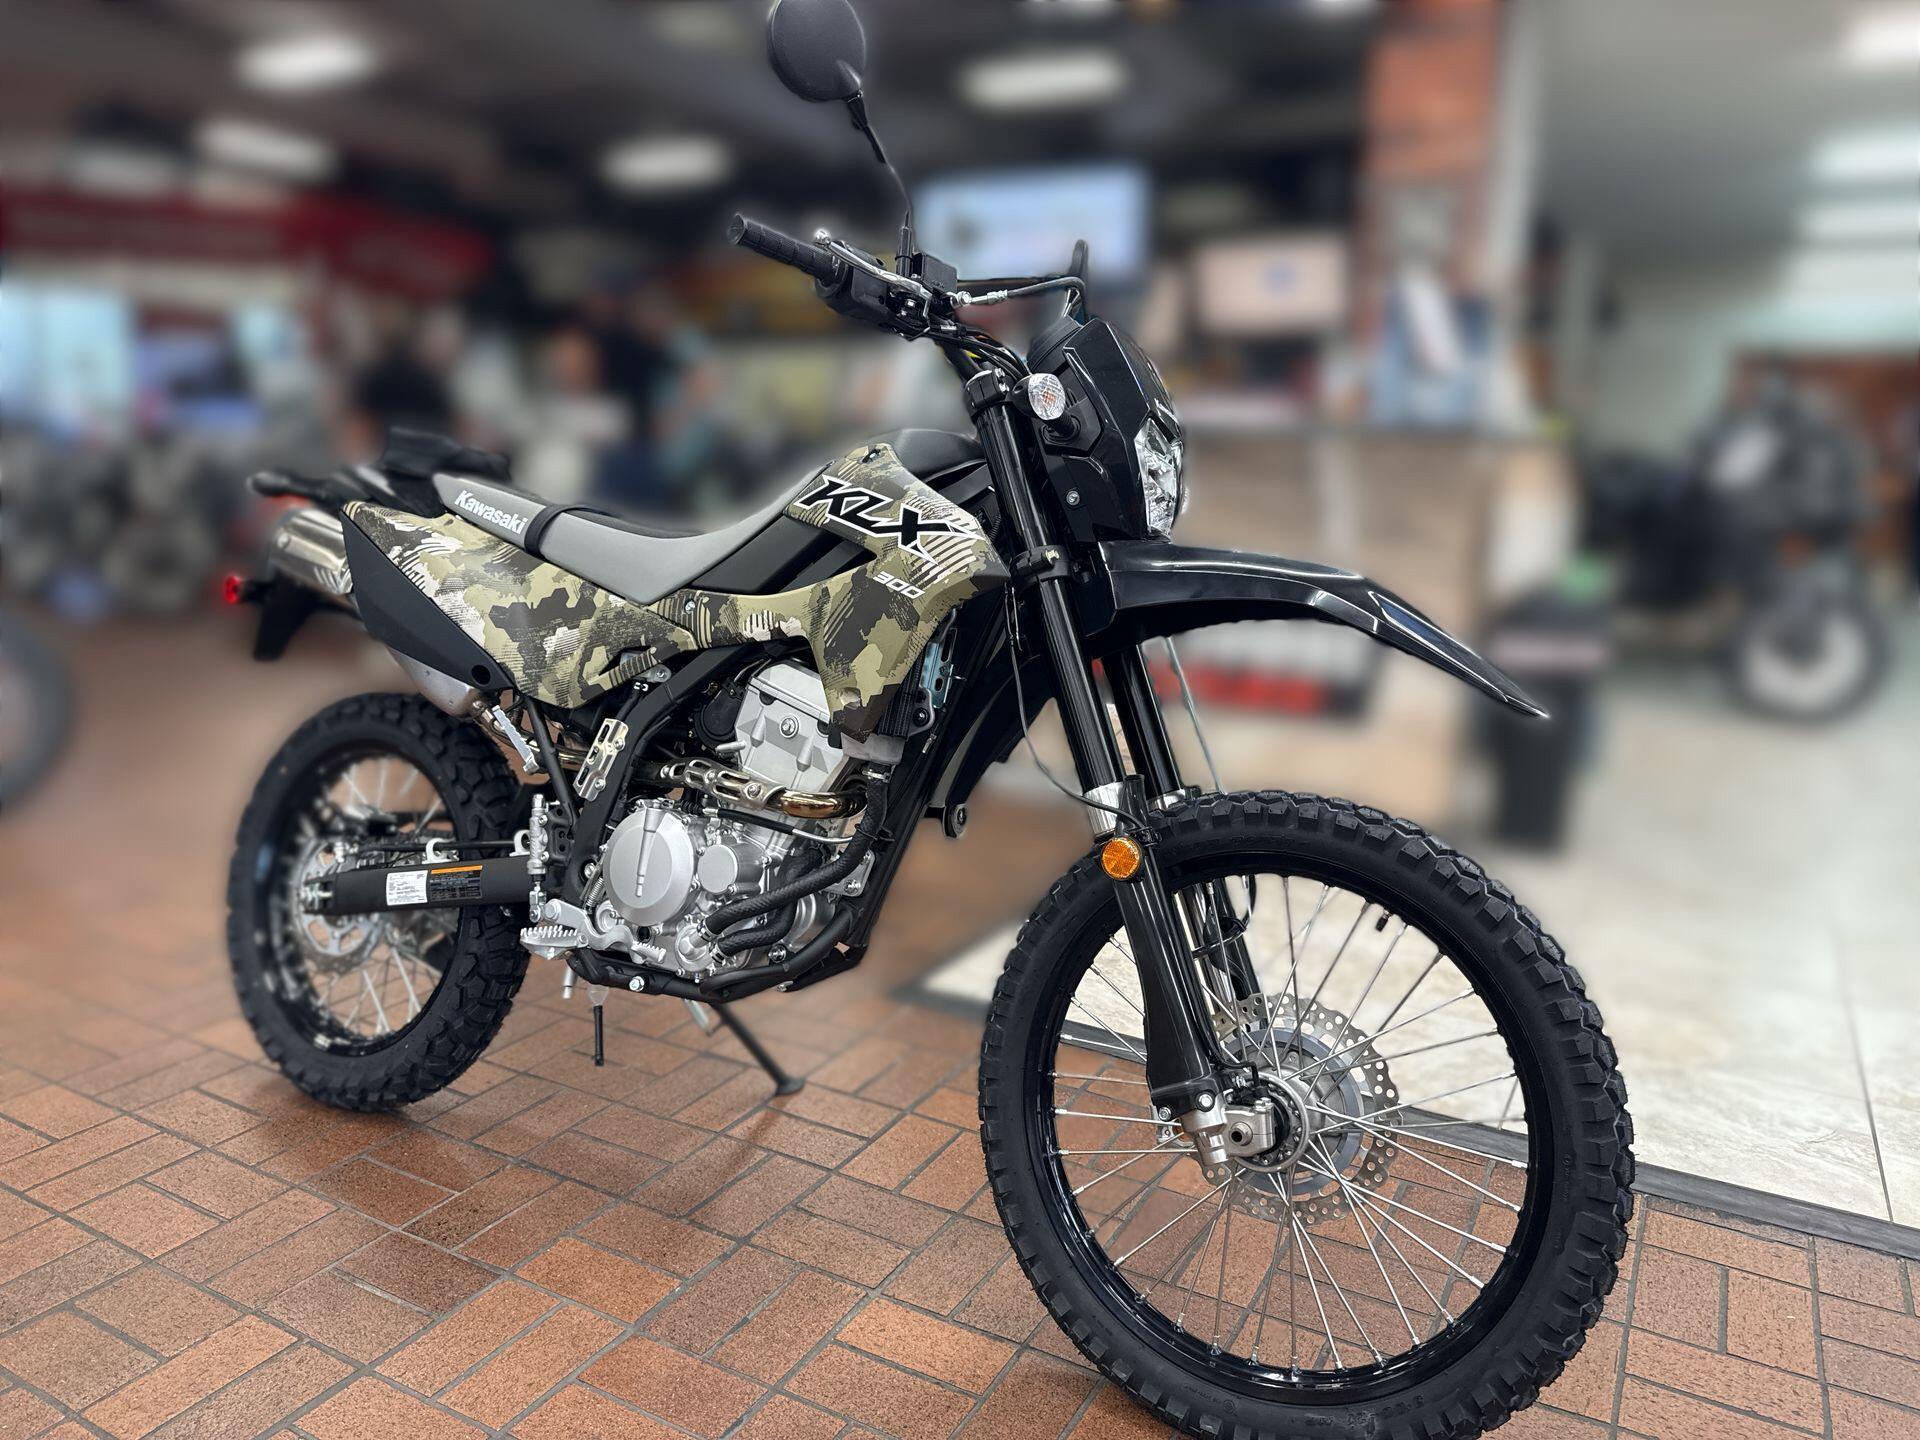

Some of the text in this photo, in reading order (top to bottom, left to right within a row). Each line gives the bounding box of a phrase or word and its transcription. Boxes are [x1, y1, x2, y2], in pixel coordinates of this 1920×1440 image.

[454, 490, 528, 535] Kawasaki
[793, 474, 986, 565] KLX
[873, 571, 925, 599] 300
